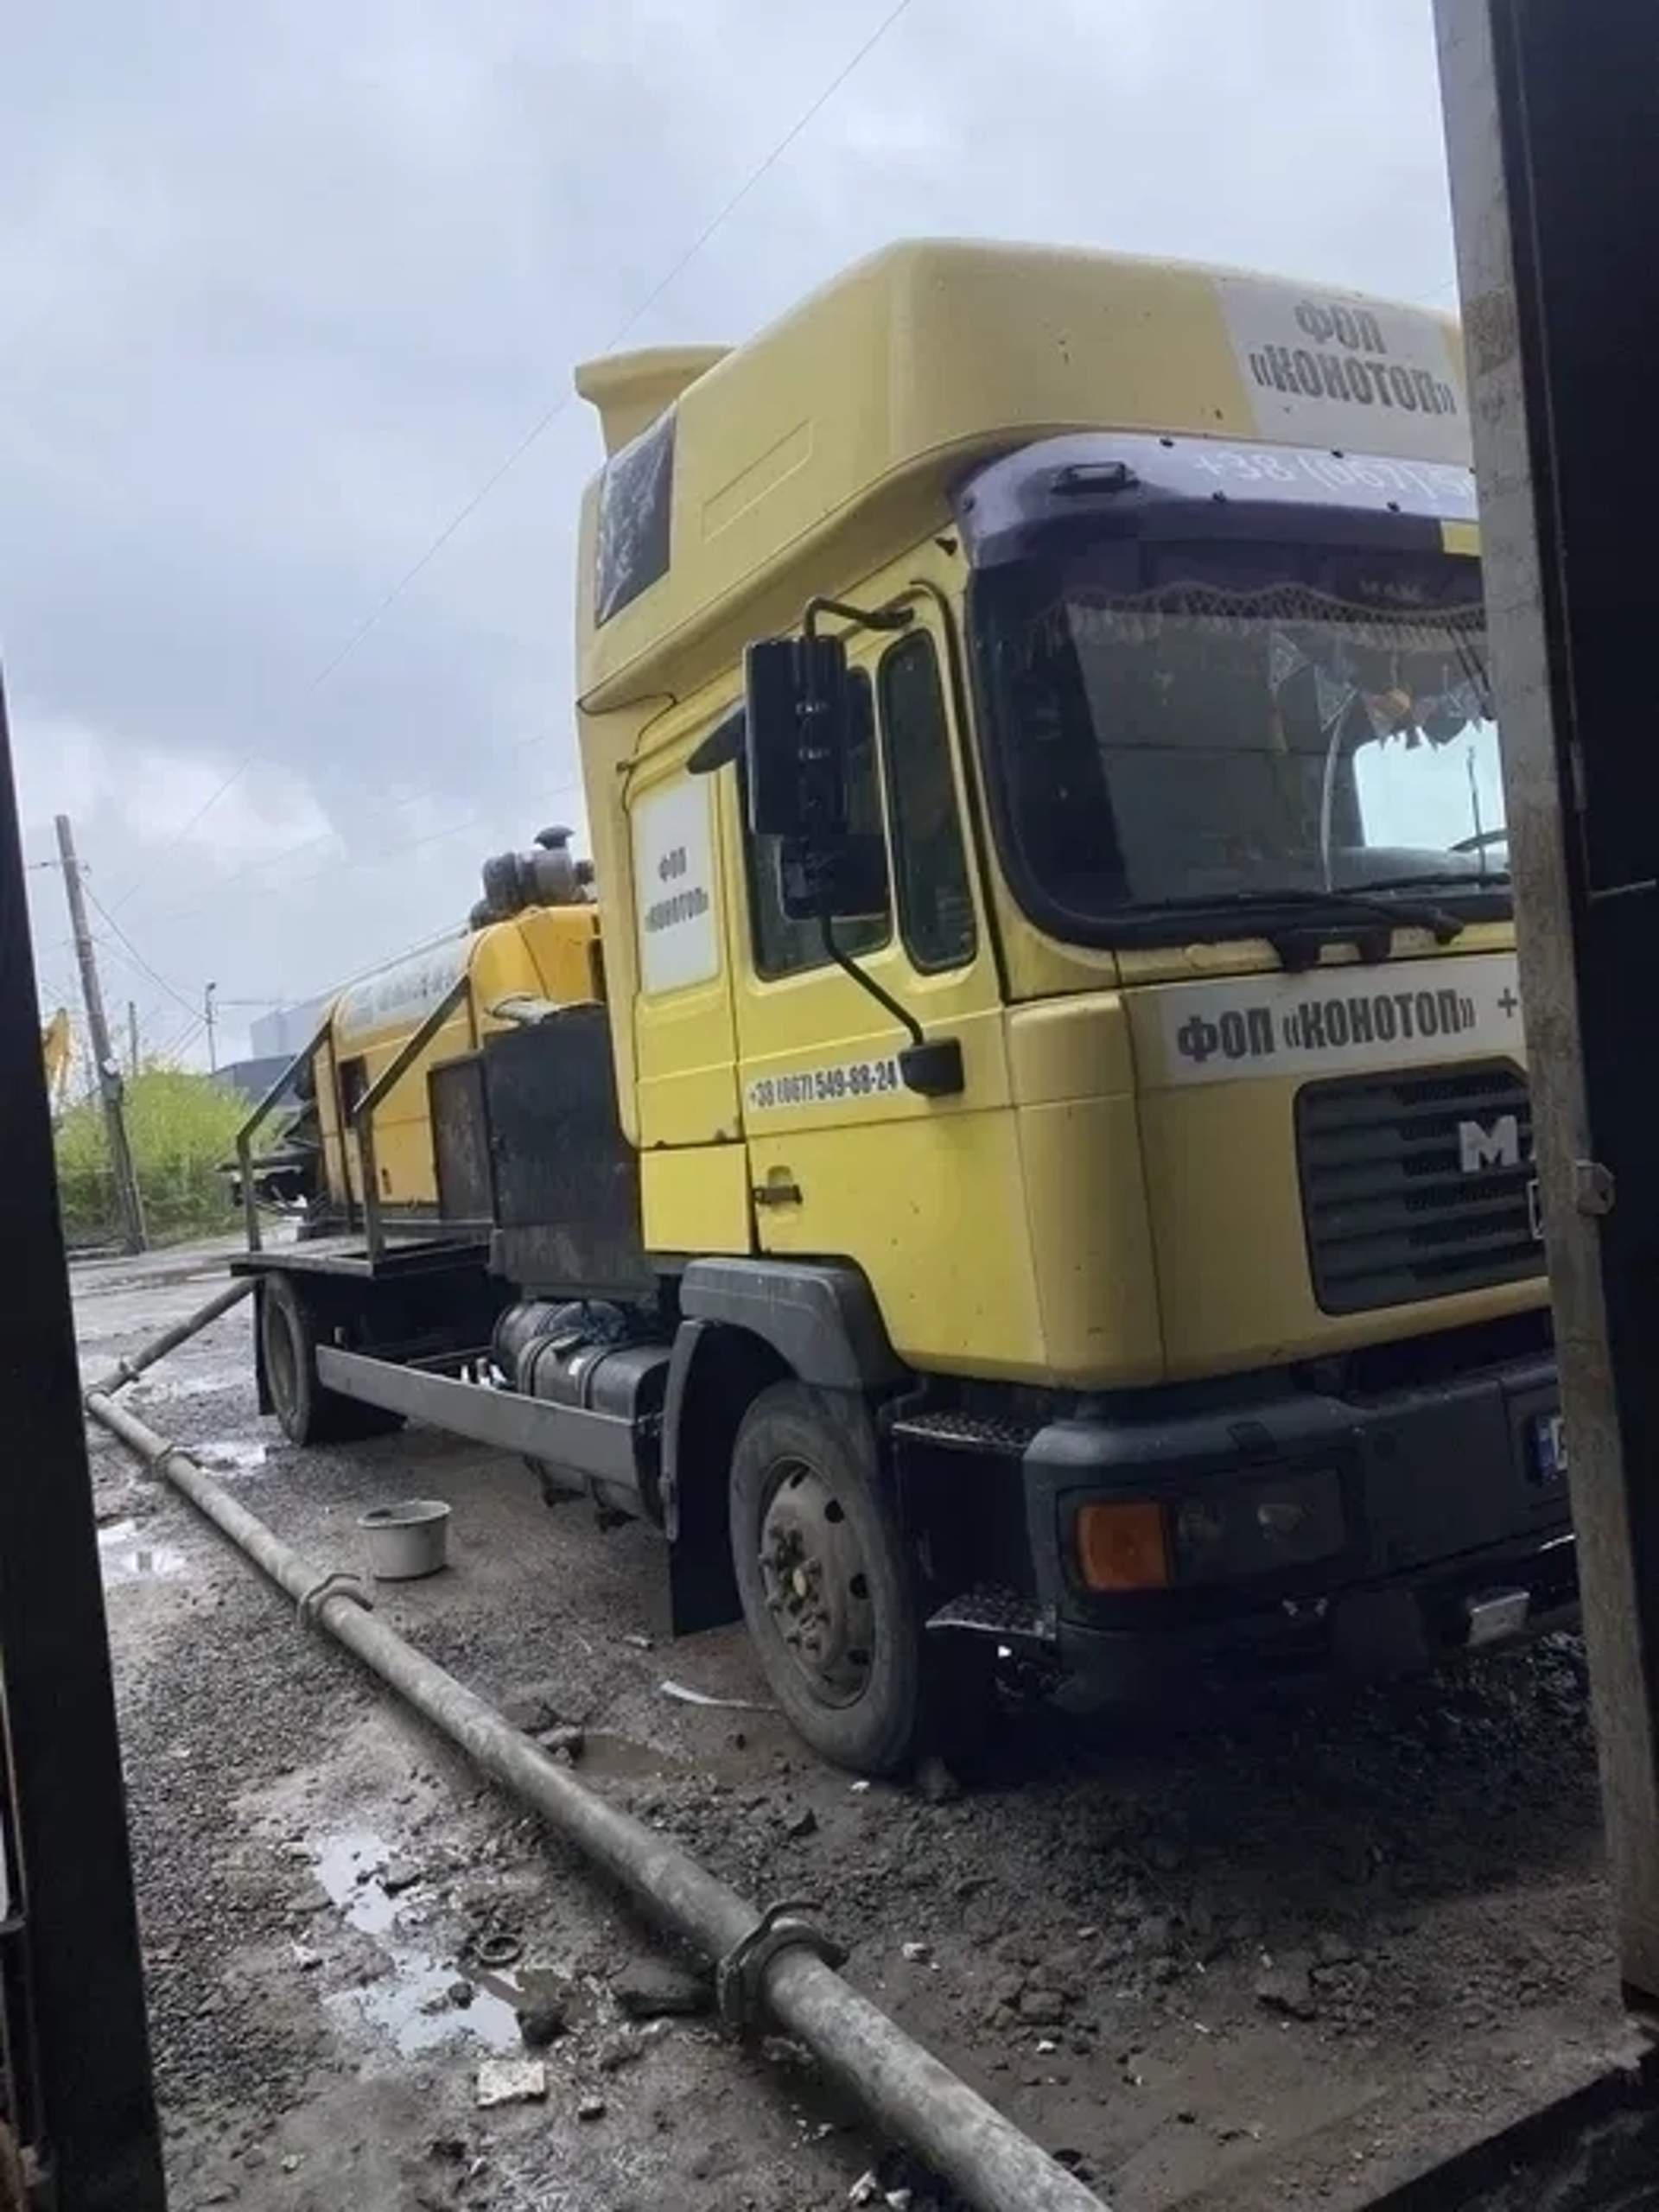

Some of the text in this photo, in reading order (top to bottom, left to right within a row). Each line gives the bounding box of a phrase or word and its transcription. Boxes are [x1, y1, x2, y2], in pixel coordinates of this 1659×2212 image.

[1294, 299, 1388, 354] ФОП
[1177, 1007, 1275, 1062] ФОП
[1283, 988, 1476, 1050] «КОНОТОП»
[1459, 1114, 1536, 1173] M
